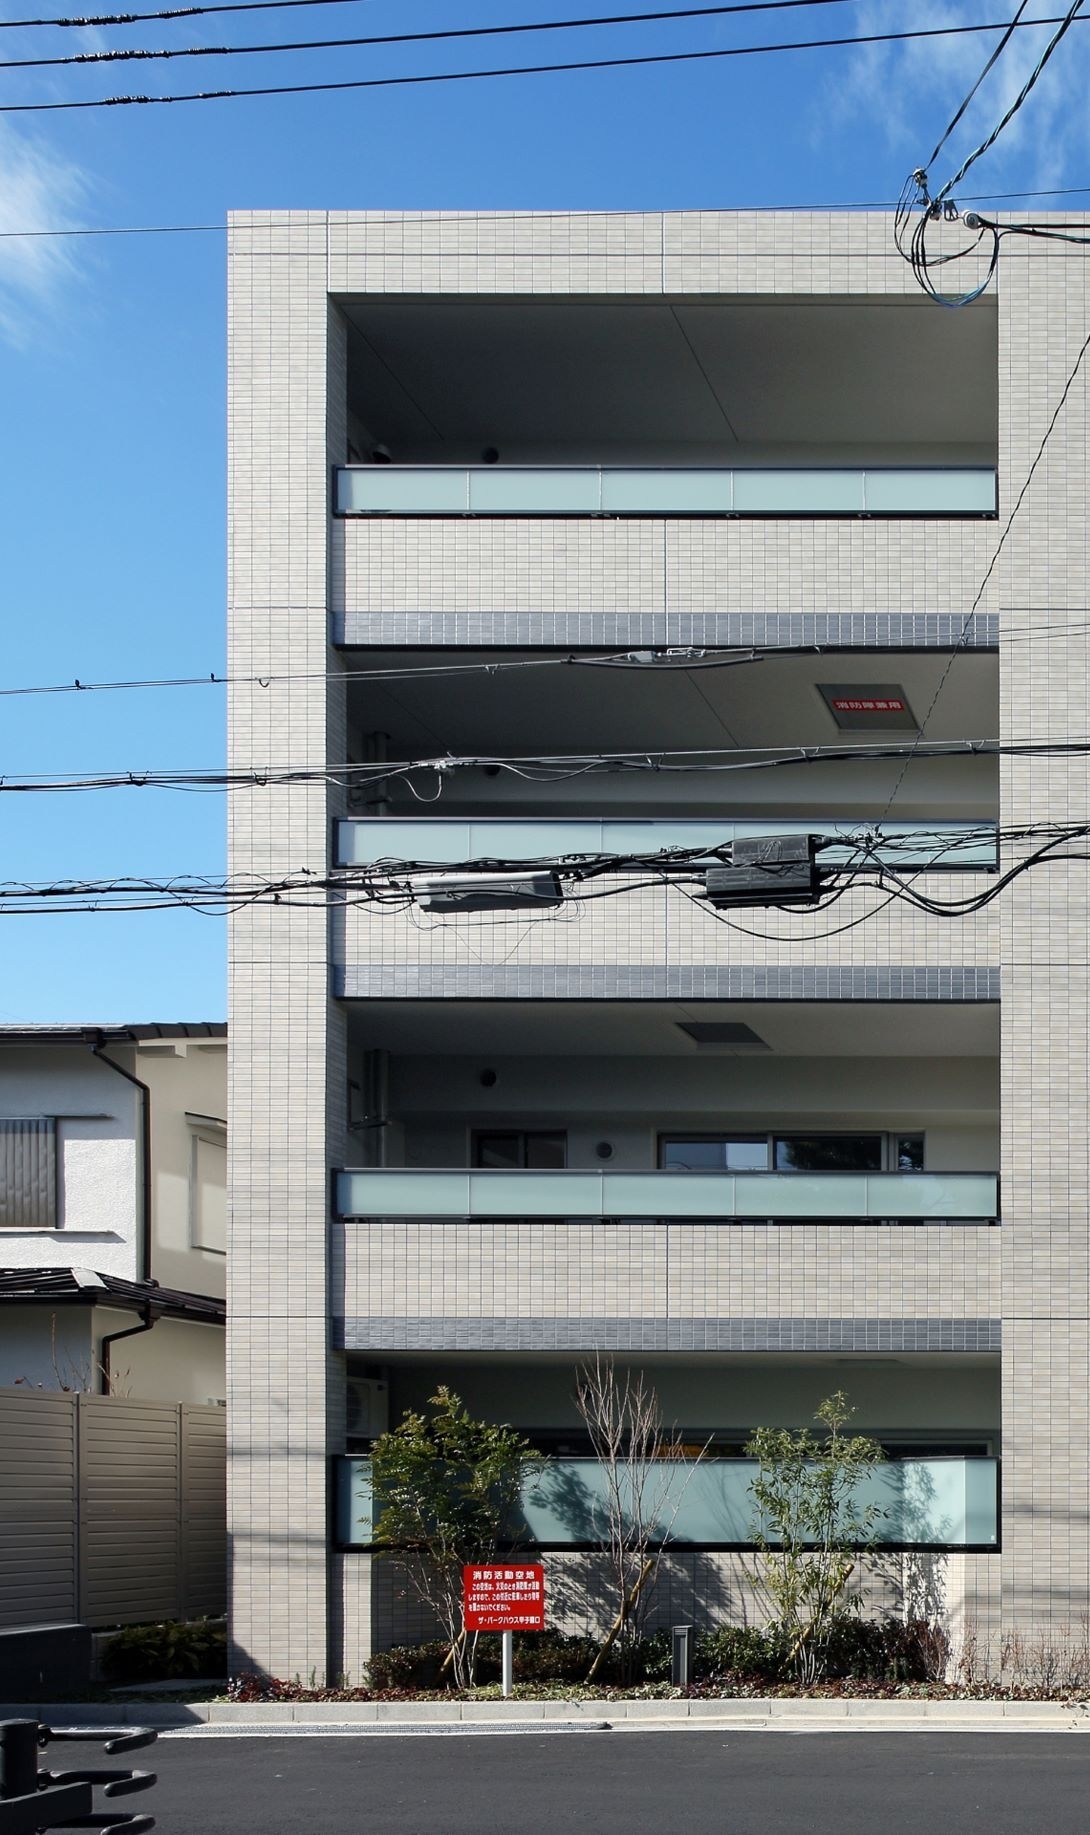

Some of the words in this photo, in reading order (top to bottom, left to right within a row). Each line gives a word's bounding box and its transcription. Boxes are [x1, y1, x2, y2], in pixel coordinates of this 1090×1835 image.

[473, 1571, 534, 1580] 消防活動空地
